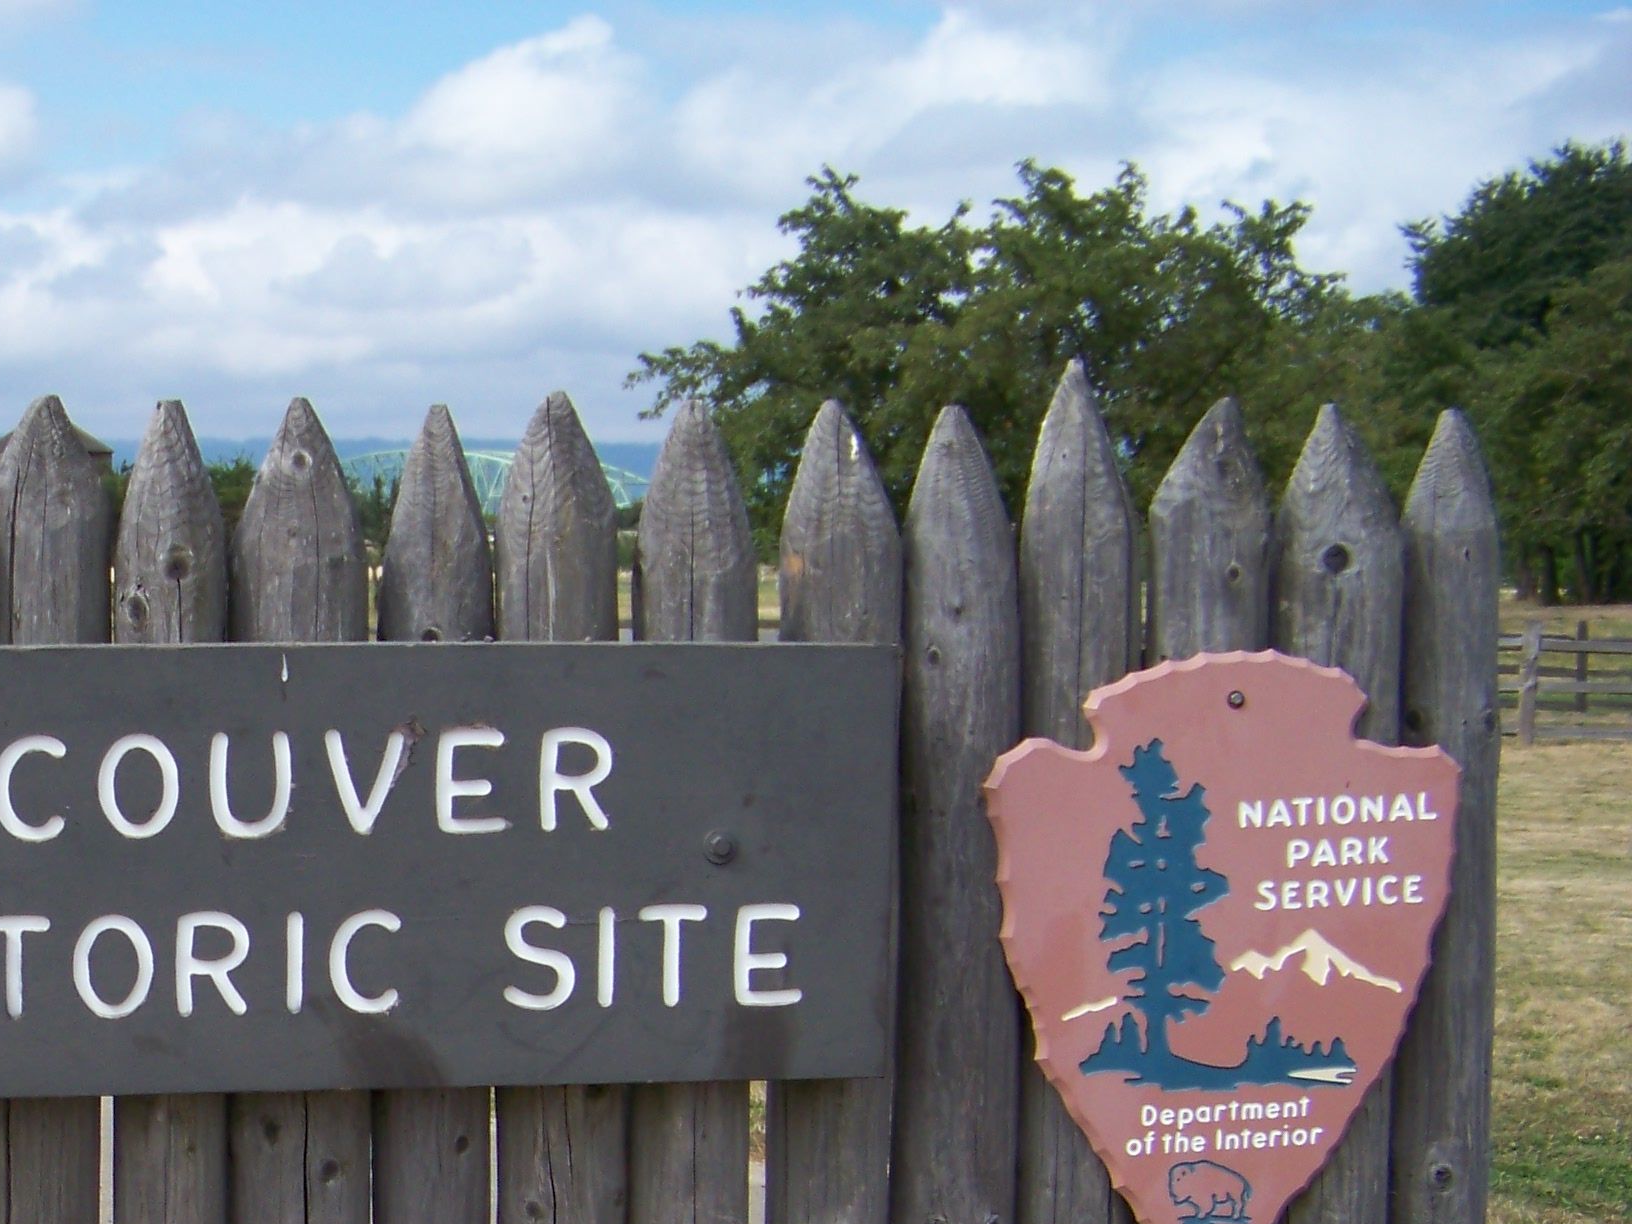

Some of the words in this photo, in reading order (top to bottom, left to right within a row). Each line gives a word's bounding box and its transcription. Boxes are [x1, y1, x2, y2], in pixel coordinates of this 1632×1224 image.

[1238, 791, 1438, 829] NATIONAL
[1287, 836, 1389, 869] PARK
[1254, 874, 1424, 911] SERVICE
[503, 902, 803, 1011] SITE
[1141, 1096, 1310, 1129] Department
[1126, 1130, 1156, 1156] of
[1162, 1132, 1206, 1154] the
[1216, 1124, 1324, 1151] Interior
